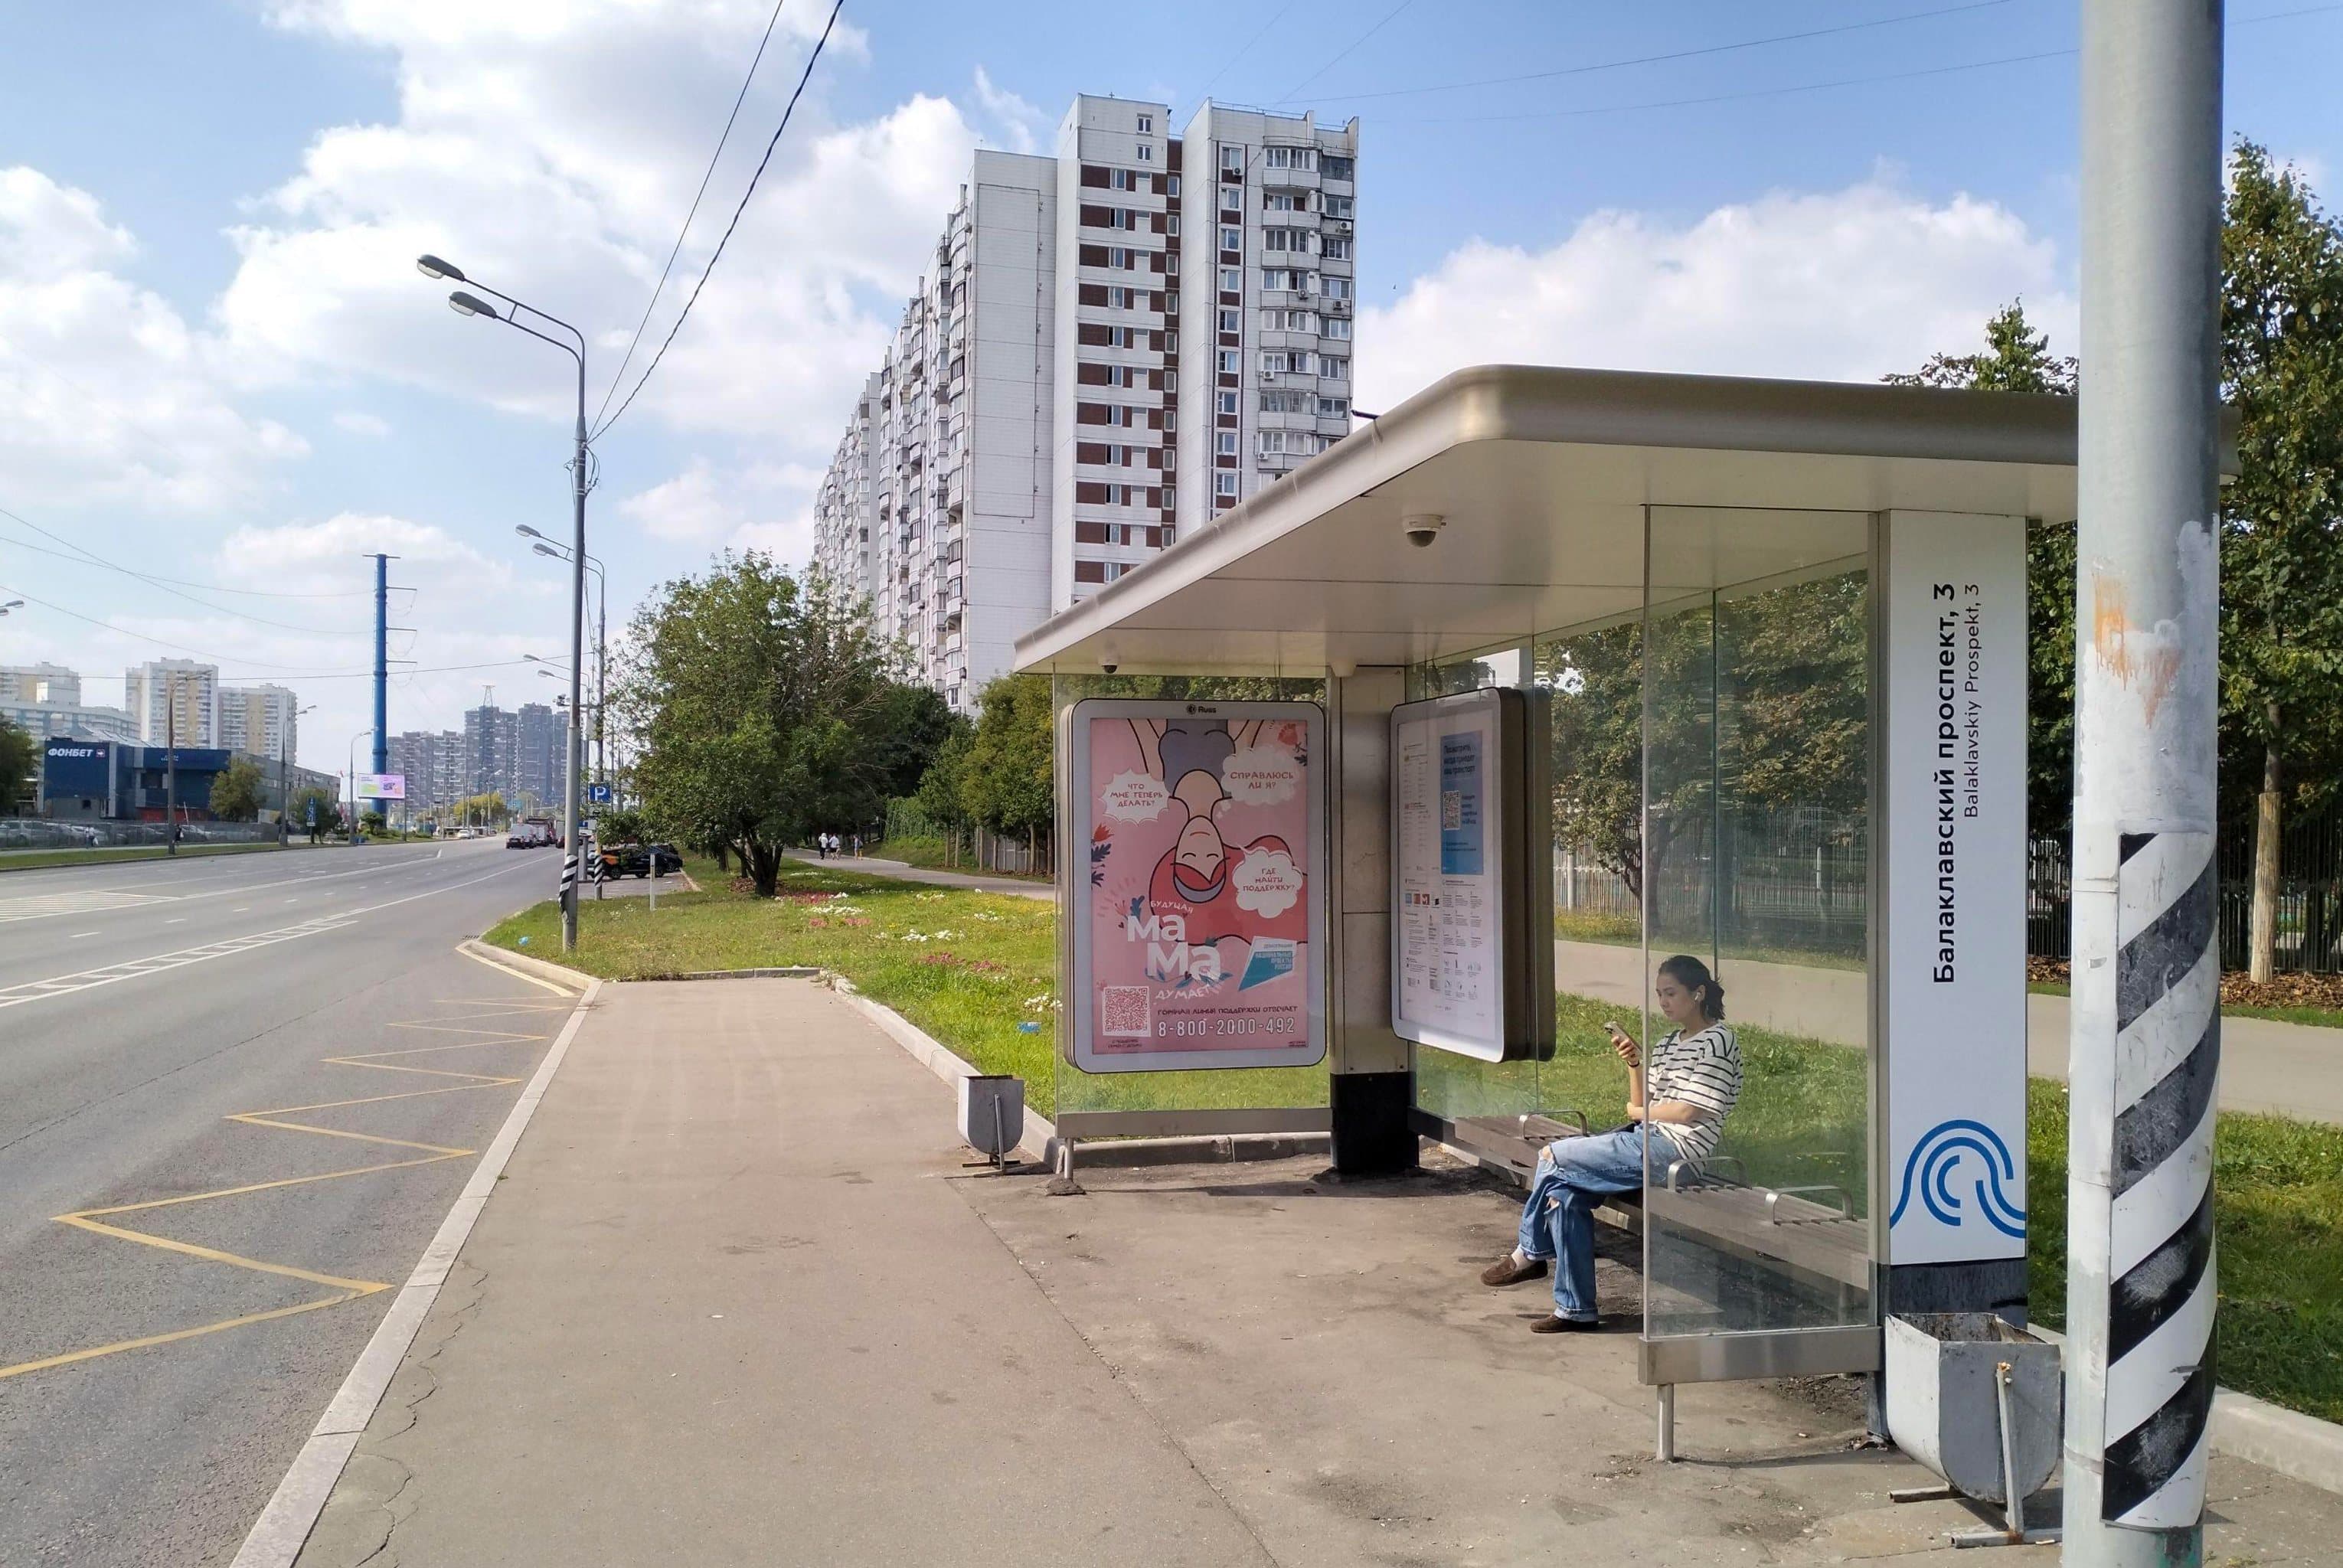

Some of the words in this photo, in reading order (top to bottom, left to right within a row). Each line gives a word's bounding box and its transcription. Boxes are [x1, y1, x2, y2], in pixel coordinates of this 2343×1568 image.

[1933, 583, 1955, 601] 3
[1965, 584, 1979, 596] 3
[1964, 603, 1982, 693] Prospekt,
[1939, 612, 1959, 758] проспект,
[47, 747, 93, 757] ФОНБЕТ
[1964, 701, 1982, 818] Balaklavskiy
[1933, 769, 1955, 982] Балаклавский
[1243, 884, 1295, 892] ПОДДЕРЖКУ?
[1158, 1017, 1295, 1037] 8-800-2000-492
